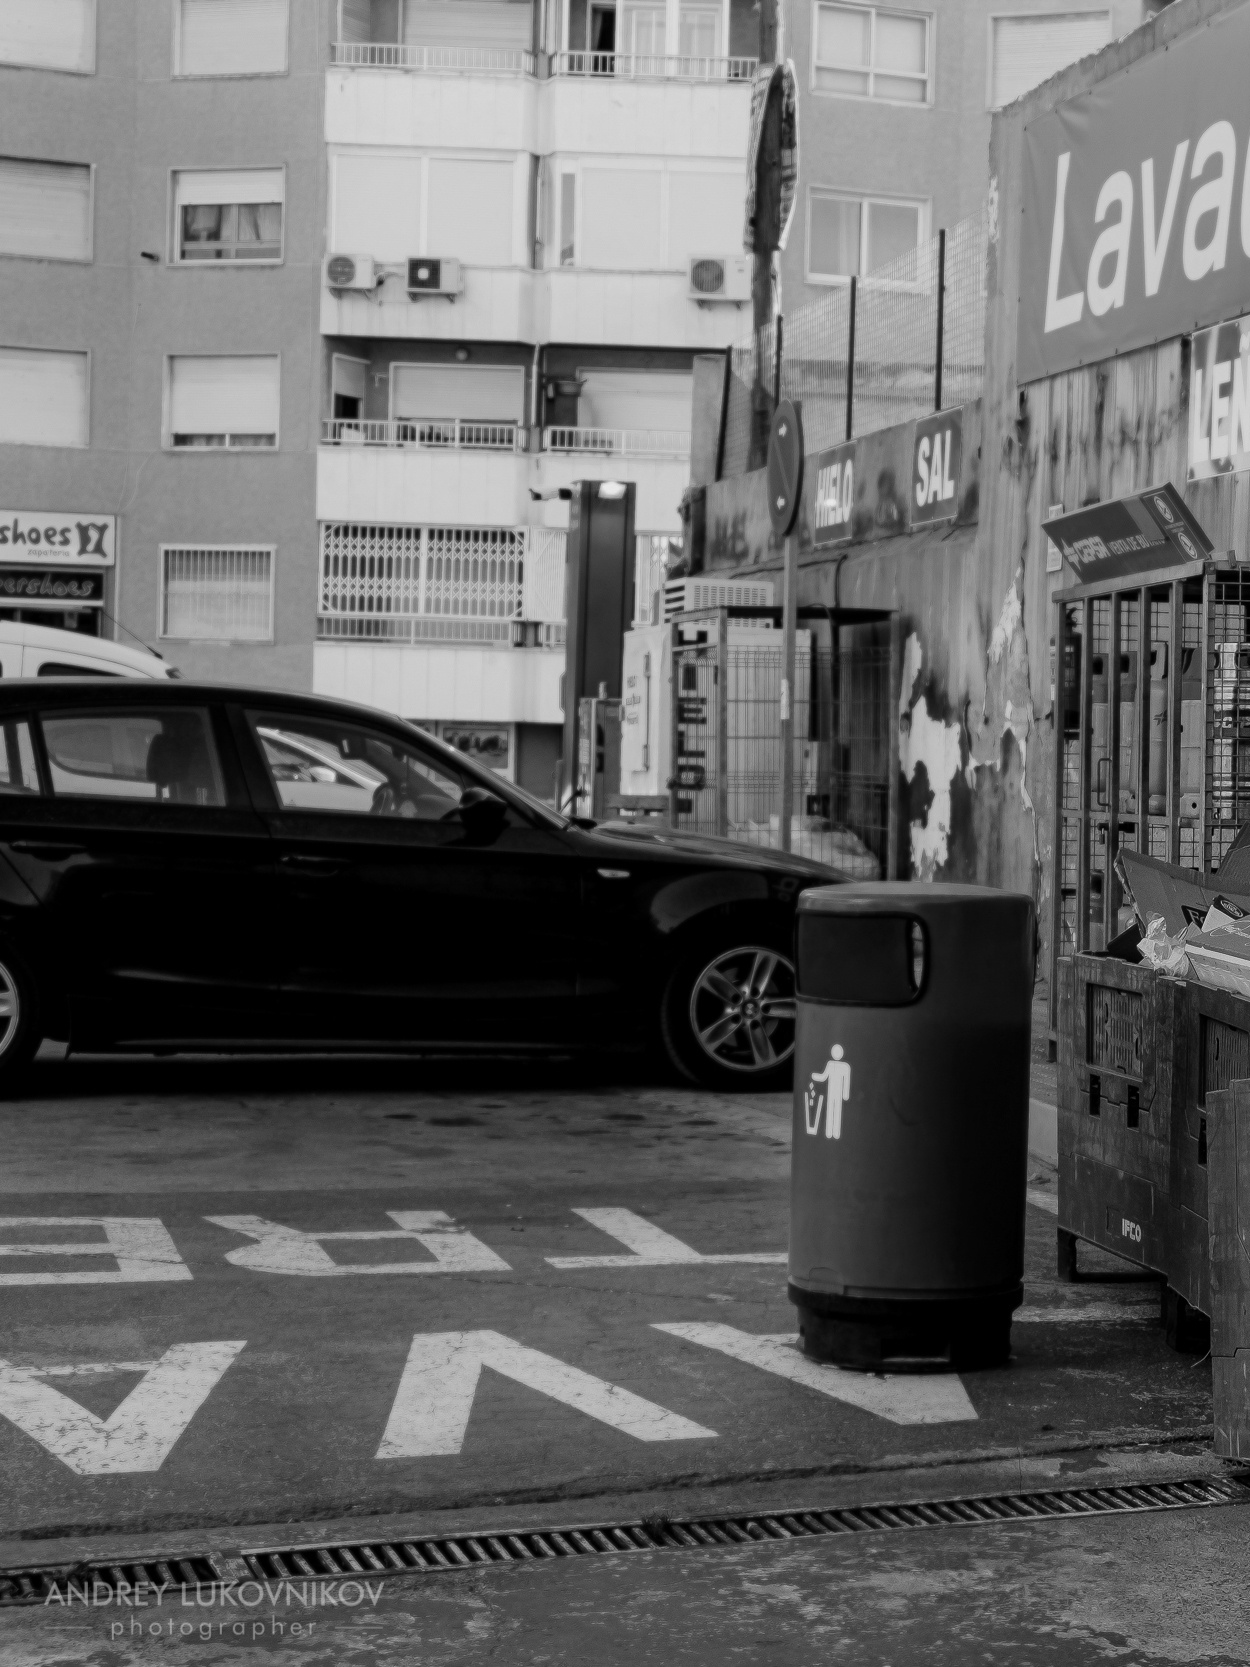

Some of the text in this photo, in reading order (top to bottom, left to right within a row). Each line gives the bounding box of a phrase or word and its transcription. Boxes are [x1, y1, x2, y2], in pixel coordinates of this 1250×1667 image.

[915, 429, 955, 507] SAL
[815, 458, 854, 529] HIELO
[1073, 535, 1112, 564] CEPSA
[1121, 1218, 1142, 1243] IFCO
